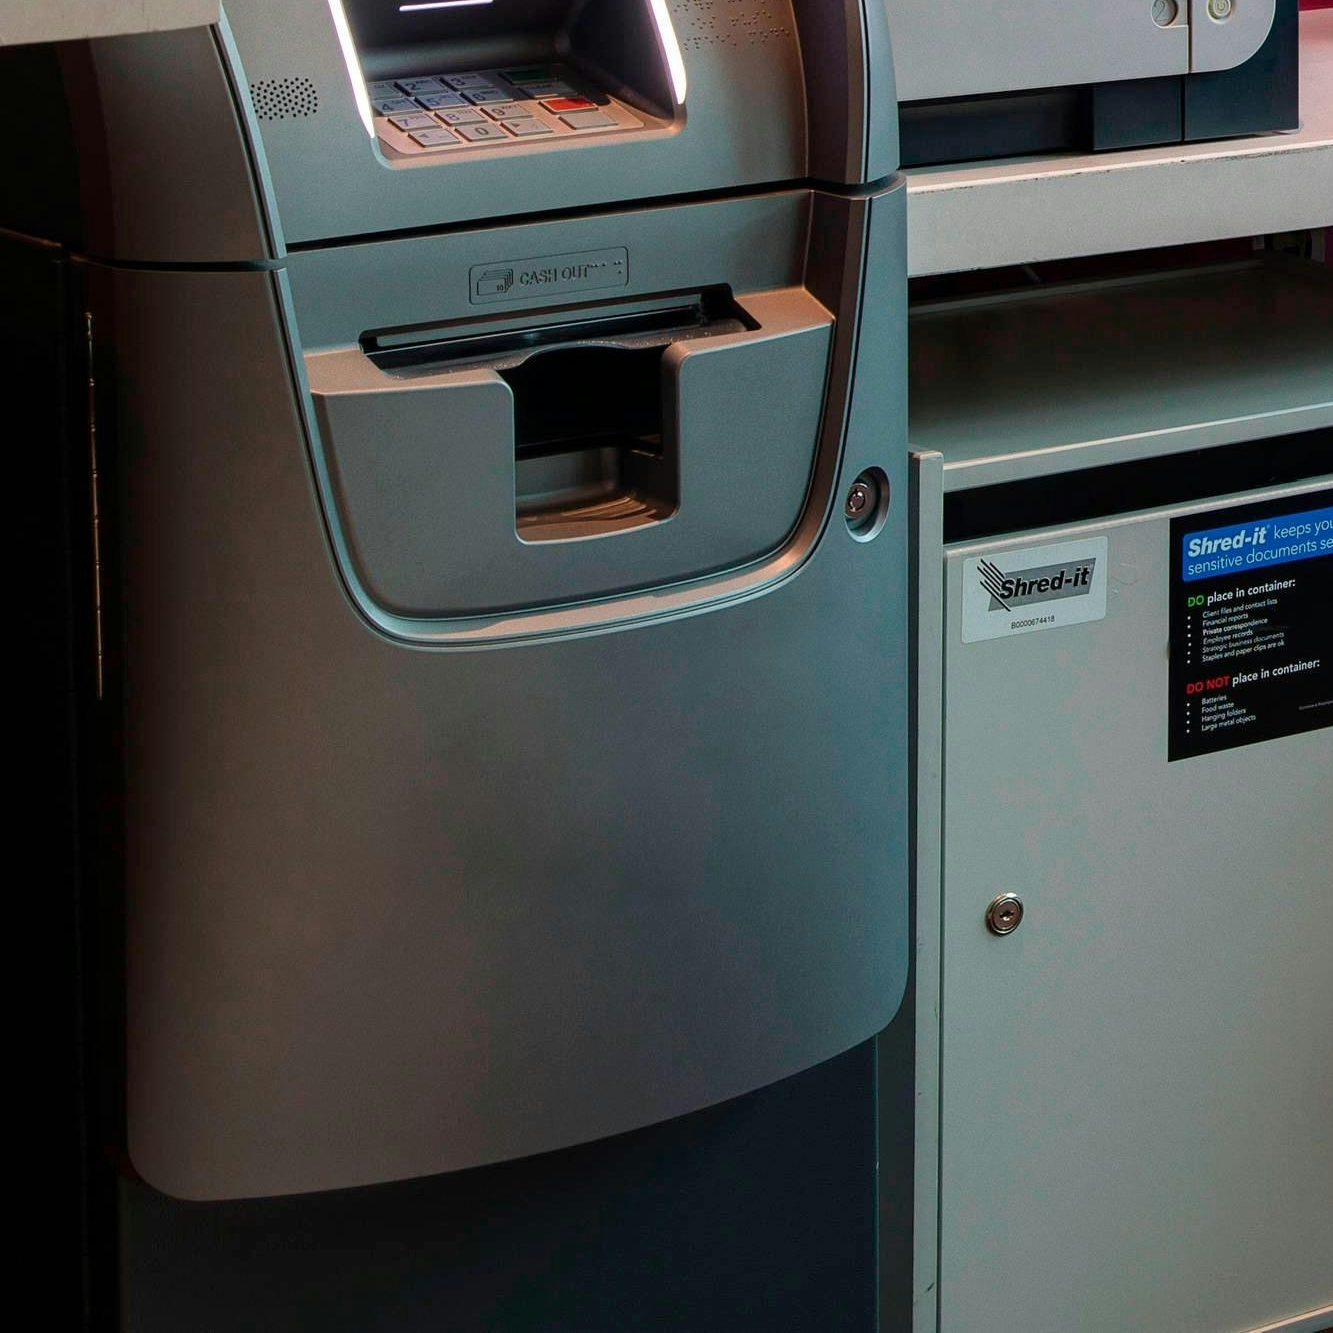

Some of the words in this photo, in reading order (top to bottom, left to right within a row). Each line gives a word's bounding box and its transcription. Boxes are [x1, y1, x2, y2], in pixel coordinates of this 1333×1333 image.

[405, 81, 417, 91] 2
[451, 77, 466, 86] 3
[427, 97, 440, 107] 5
[472, 93, 486, 102] 6
[382, 103, 394, 112] 4
[491, 107, 505, 117] 9
[397, 117, 410, 127] 7
[446, 112, 461, 122] 8
[474, 127, 490, 136] 0
[520, 269, 557, 286] CASH
[562, 265, 587, 280] OUT
[1273, 522, 1312, 540] keeps
[1187, 554, 1243, 576] sensitive
[1246, 540, 1317, 564] documents
[1000, 566, 1090, 600] Shred-it
[1187, 595, 1205, 607] DO
[1207, 591, 1234, 606] place
[1235, 587, 1245, 598] in
[1247, 578, 1296, 596] container:
[1202, 610, 1220, 618] Client
[1220, 607, 1232, 615] files
[1233, 604, 1244, 613] and
[1245, 600, 1266, 610] contact
[1266, 598, 1278, 606] lists
[1011, 615, 1055, 629] B0000674418
[1202, 616, 1228, 626] Financial
[1228, 613, 1249, 623] reports
[1202, 627, 1222, 636] Private
[1223, 618, 1268, 632] correspondence
[1202, 643, 1228, 654] Strategic
[1228, 638, 1252, 649] business
[1253, 632, 1285, 644] documents
[1203, 635, 1231, 645] Employee
[1232, 629, 1254, 639] records
[1202, 652, 1224, 663] Staples
[1224, 649, 1235, 658] and
[1235, 647, 1253, 657] paper
[1253, 643, 1266, 653] clips
[1277, 639, 1285, 647] ok
[1186, 682, 1204, 695] DO
[1206, 675, 1231, 691] NOT
[1232, 672, 1258, 687] place
[1260, 668, 1270, 679] in
[1272, 659, 1320, 677] container:
[1201, 695, 1227, 705] Batteries
[1201, 704, 1218, 714] Food
[1218, 702, 1235, 710] waste
[1201, 713, 1226, 722] Hanging
[1226, 708, 1247, 717] folders
[1201, 723, 1218, 731] Large
[1218, 717, 1235, 728] metal
[1235, 715, 1257, 725] objects
